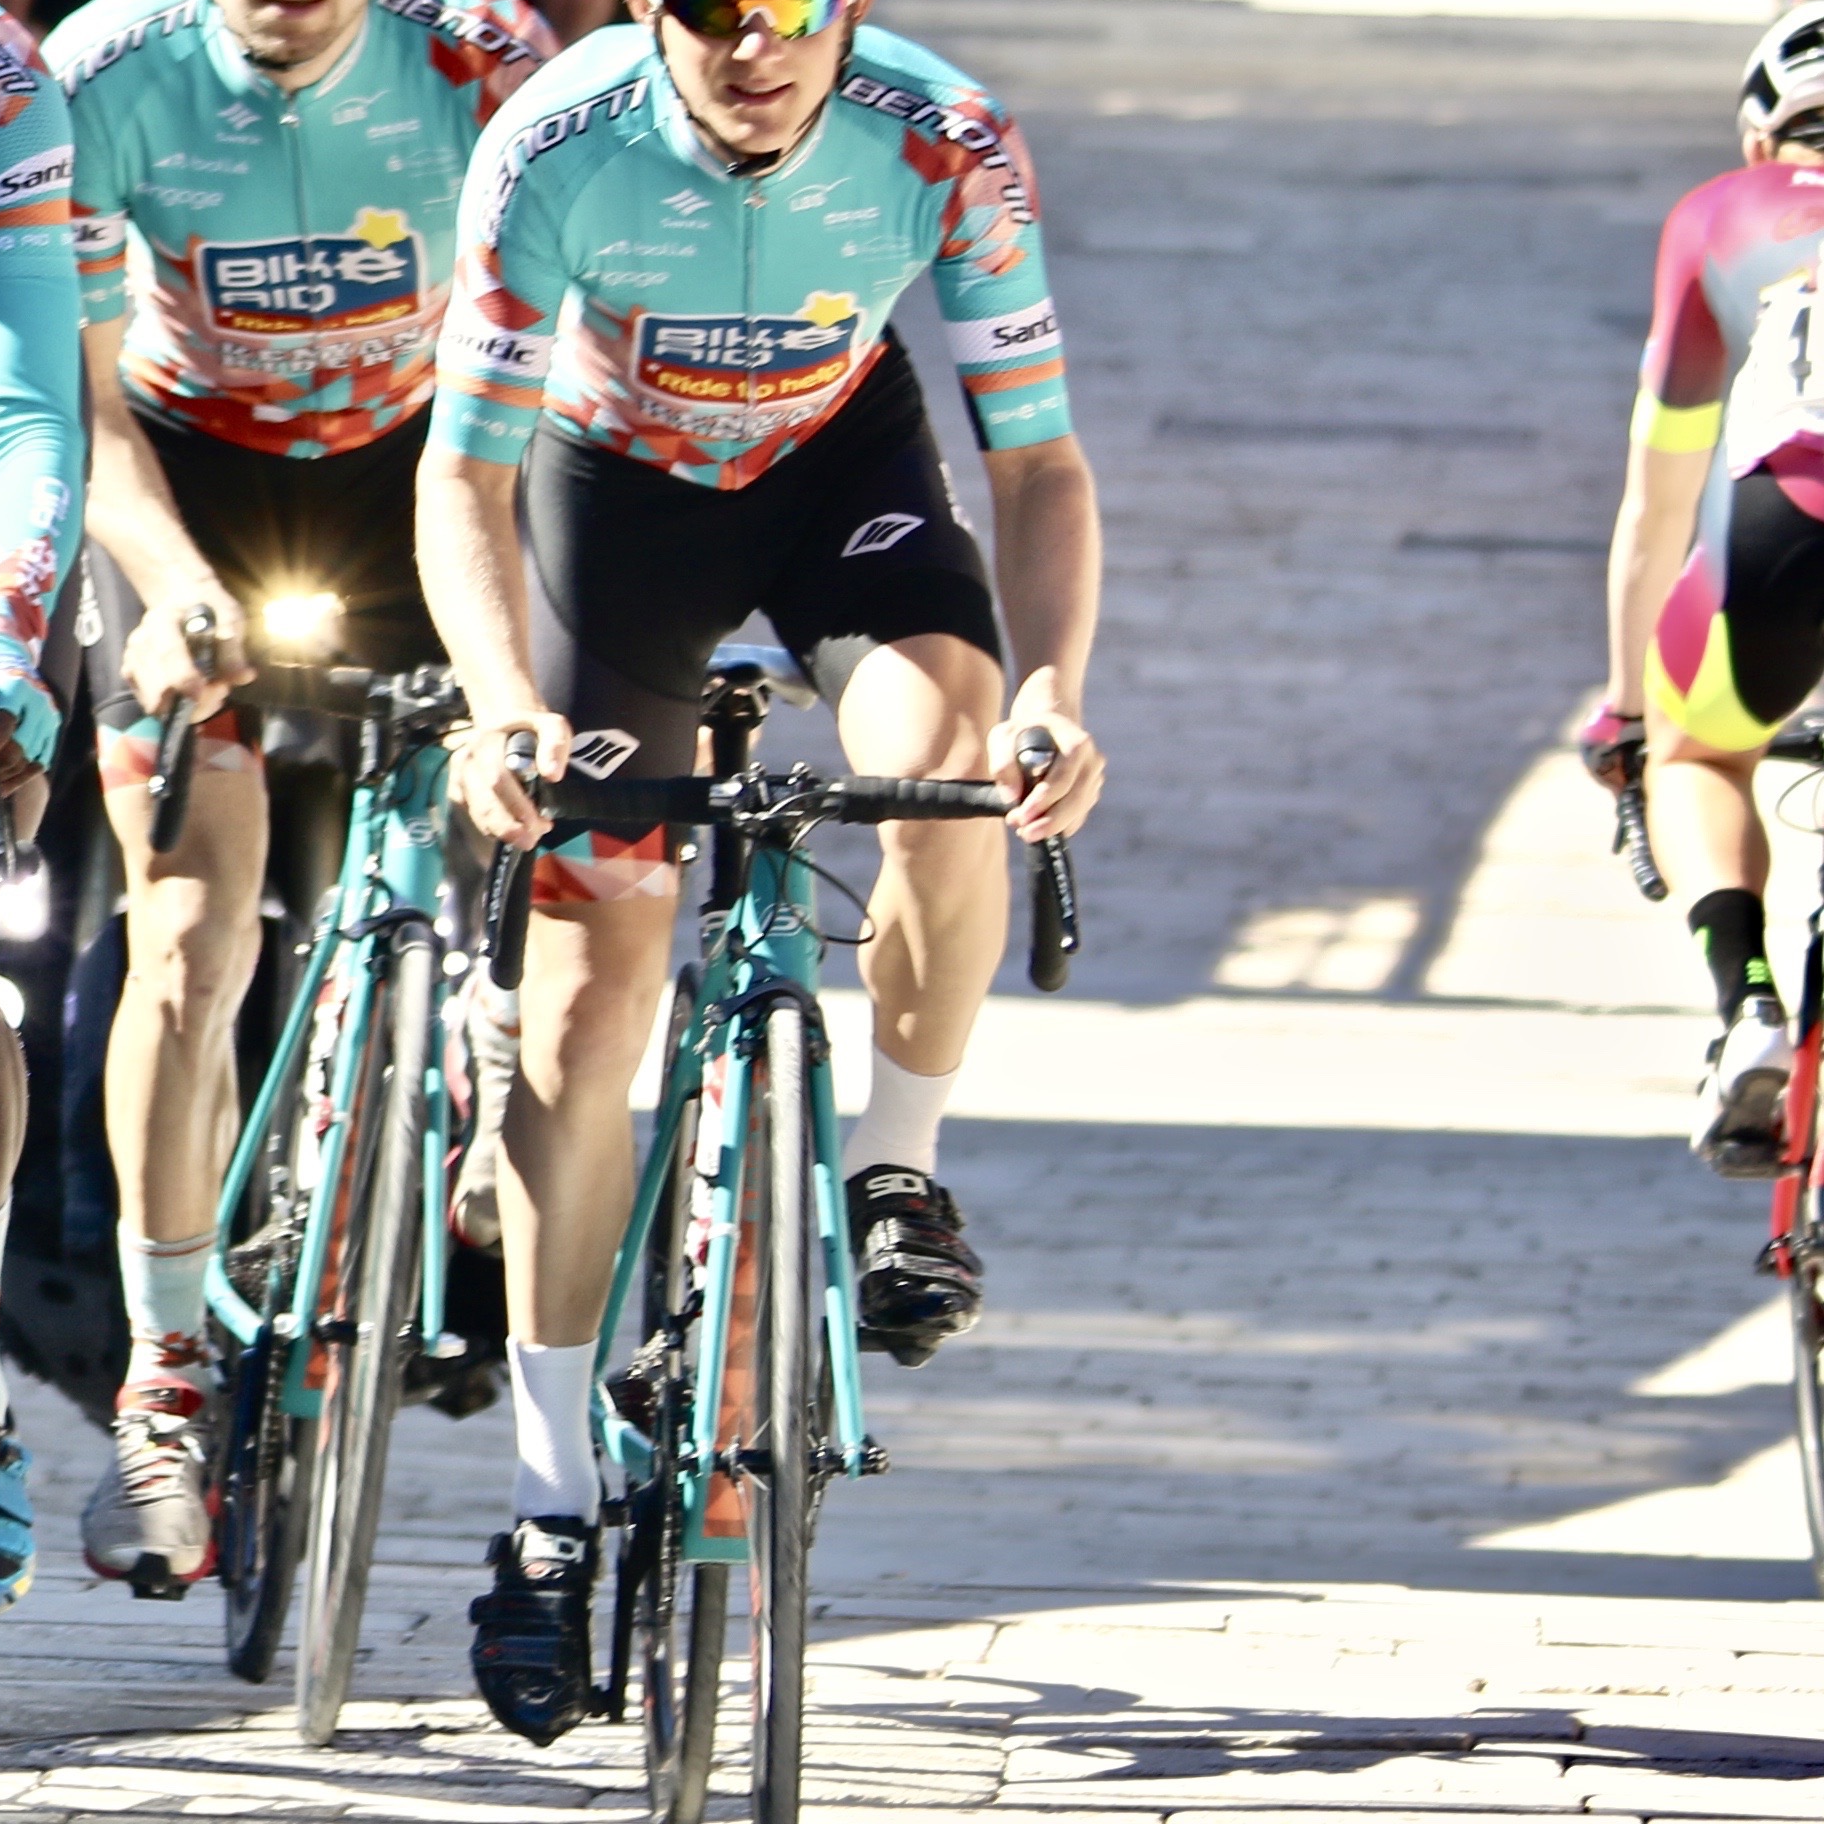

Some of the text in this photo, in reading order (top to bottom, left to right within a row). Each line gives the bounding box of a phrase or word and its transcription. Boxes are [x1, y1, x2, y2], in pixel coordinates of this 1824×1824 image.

[838, 74, 1033, 225] BENOTTI
[0, 159, 72, 199] Sant
[656, 364, 734, 398] Ride
[779, 360, 845, 397] help
